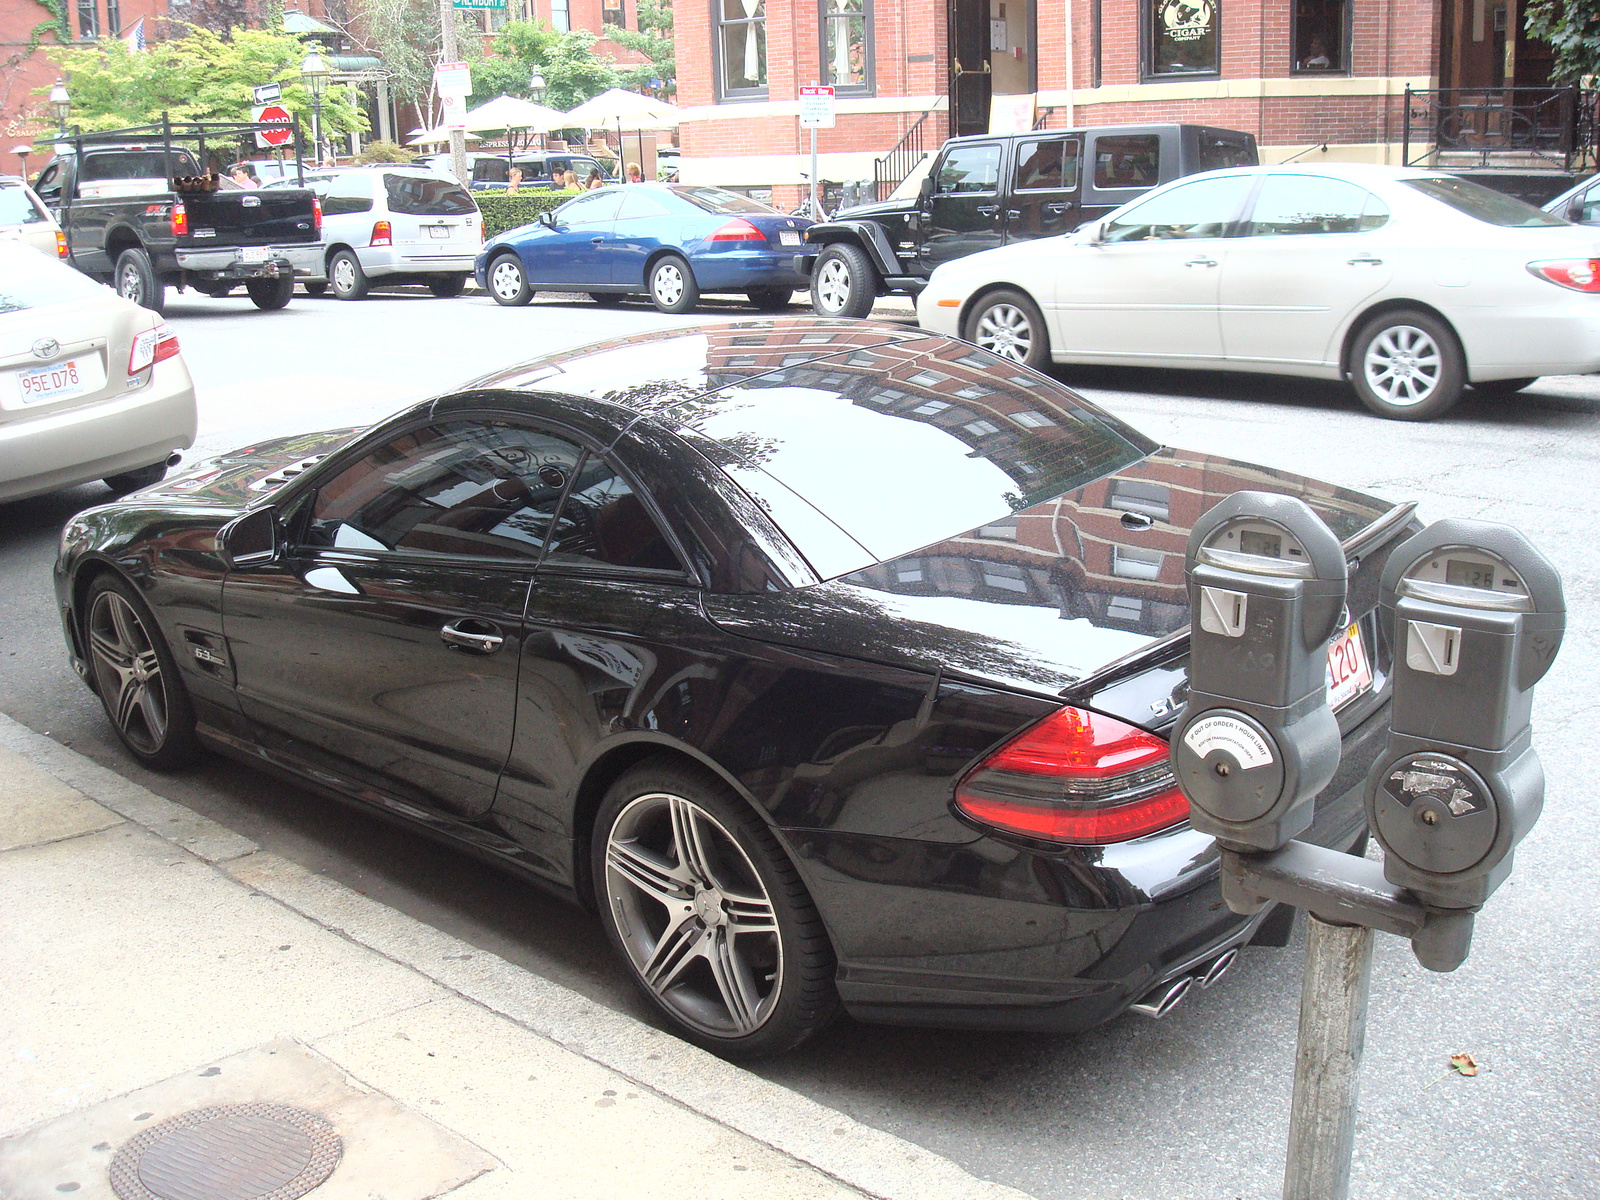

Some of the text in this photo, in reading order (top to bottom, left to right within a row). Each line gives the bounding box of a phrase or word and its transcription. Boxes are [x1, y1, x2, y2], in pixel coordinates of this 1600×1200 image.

[1170, 28, 1206, 37] CIGAR
[22, 374, 51, 394] 95E
[51, 368, 79, 389] D78
[1327, 638, 1358, 690] 120
[1150, 695, 1184, 718] SL
[1194, 725, 1204, 736] OUT
[1204, 721, 1212, 729] OF
[1213, 720, 1234, 728] ORDER
[1239, 727, 1256, 741] HOUR
[1253, 740, 1267, 756] LIMIT
[1211, 736, 1245, 750] TRANSPORTATION
